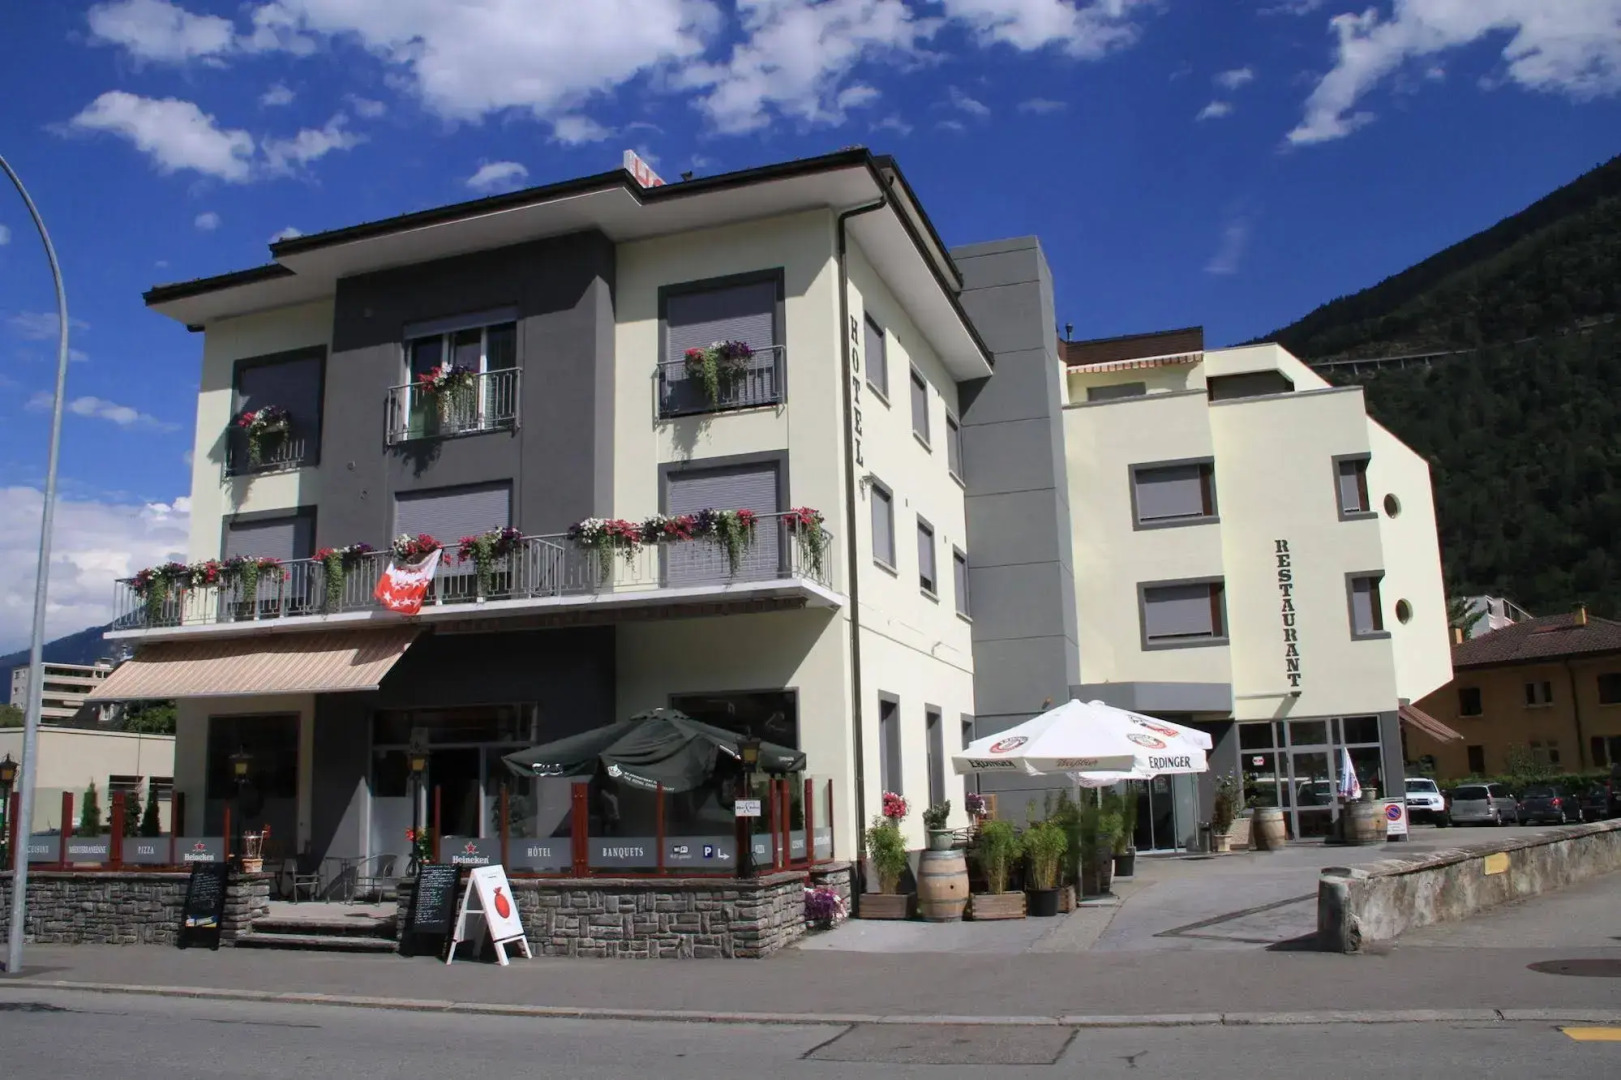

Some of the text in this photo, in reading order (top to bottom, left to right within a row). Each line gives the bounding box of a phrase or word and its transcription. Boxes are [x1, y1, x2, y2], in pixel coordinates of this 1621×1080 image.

[850, 315, 864, 468] HOTEL
[1274, 539, 1301, 687] RESTAURANT
[968, 759, 1016, 769] ERDINGER
[1148, 756, 1191, 769] ERDINGER
[138, 845, 154, 854] PIZZA
[527, 845, 551, 857] HÔTEL
[602, 847, 644, 859] BANQUETS
[184, 853, 214, 861] Heineken
[452, 855, 489, 864] Heineken
